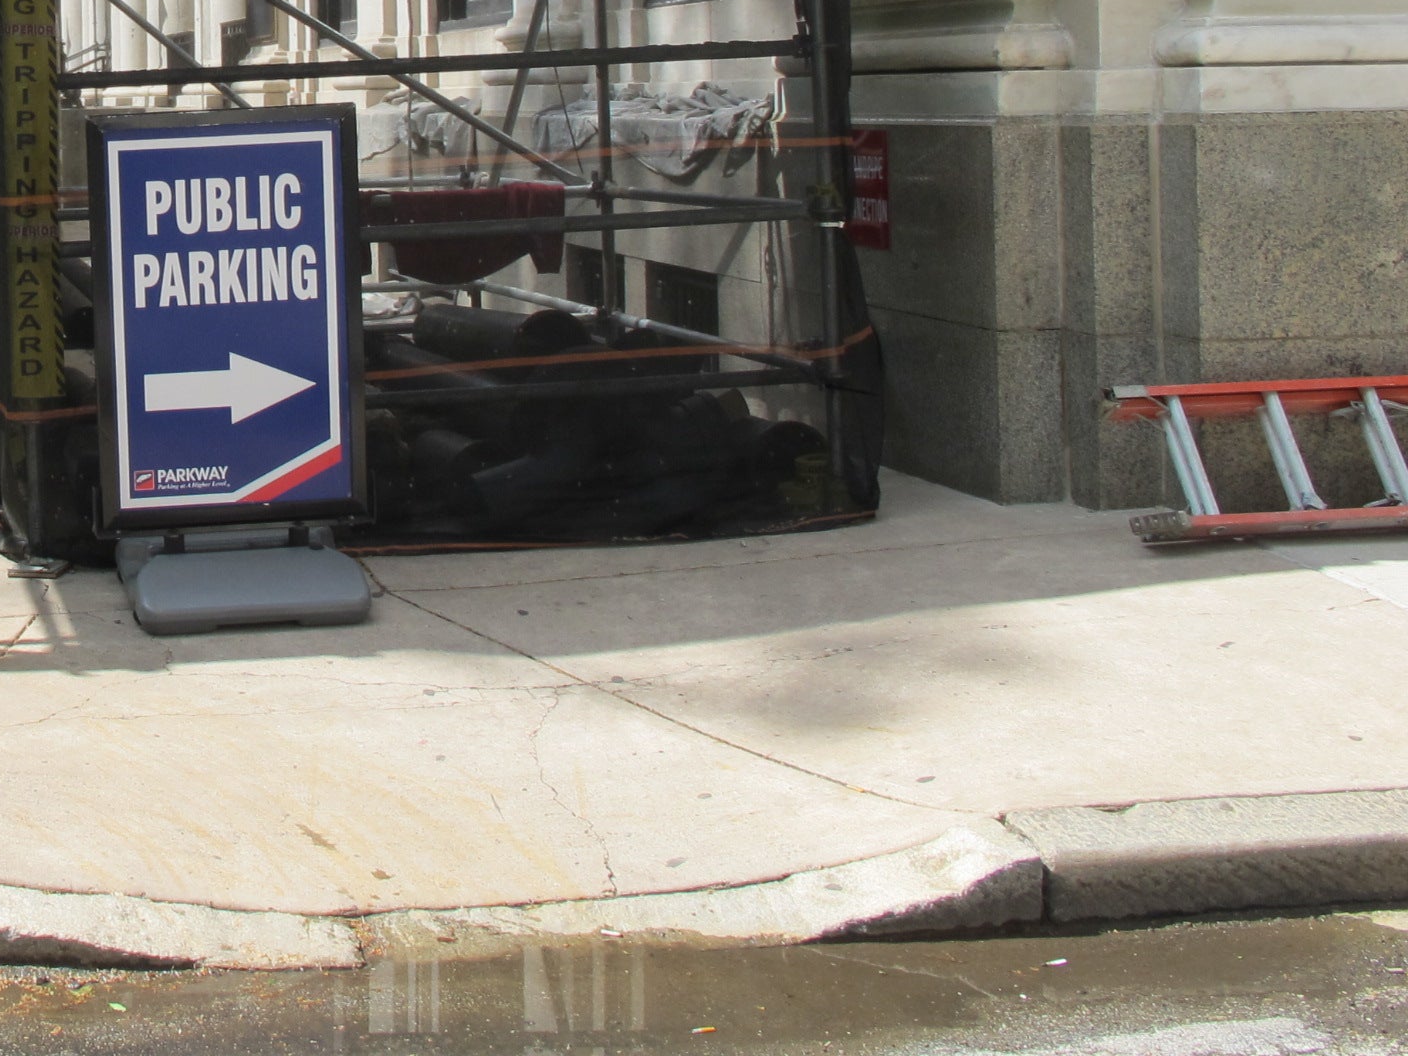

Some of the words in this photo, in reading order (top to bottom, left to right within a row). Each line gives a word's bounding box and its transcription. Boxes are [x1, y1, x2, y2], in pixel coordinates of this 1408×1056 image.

[13, 42, 38, 219] TRIPPING
[145, 172, 302, 236] PUBLIC
[133, 244, 318, 309] PARKING
[15, 246, 43, 376] HAZARD
[157, 465, 229, 483] PARKWAY
